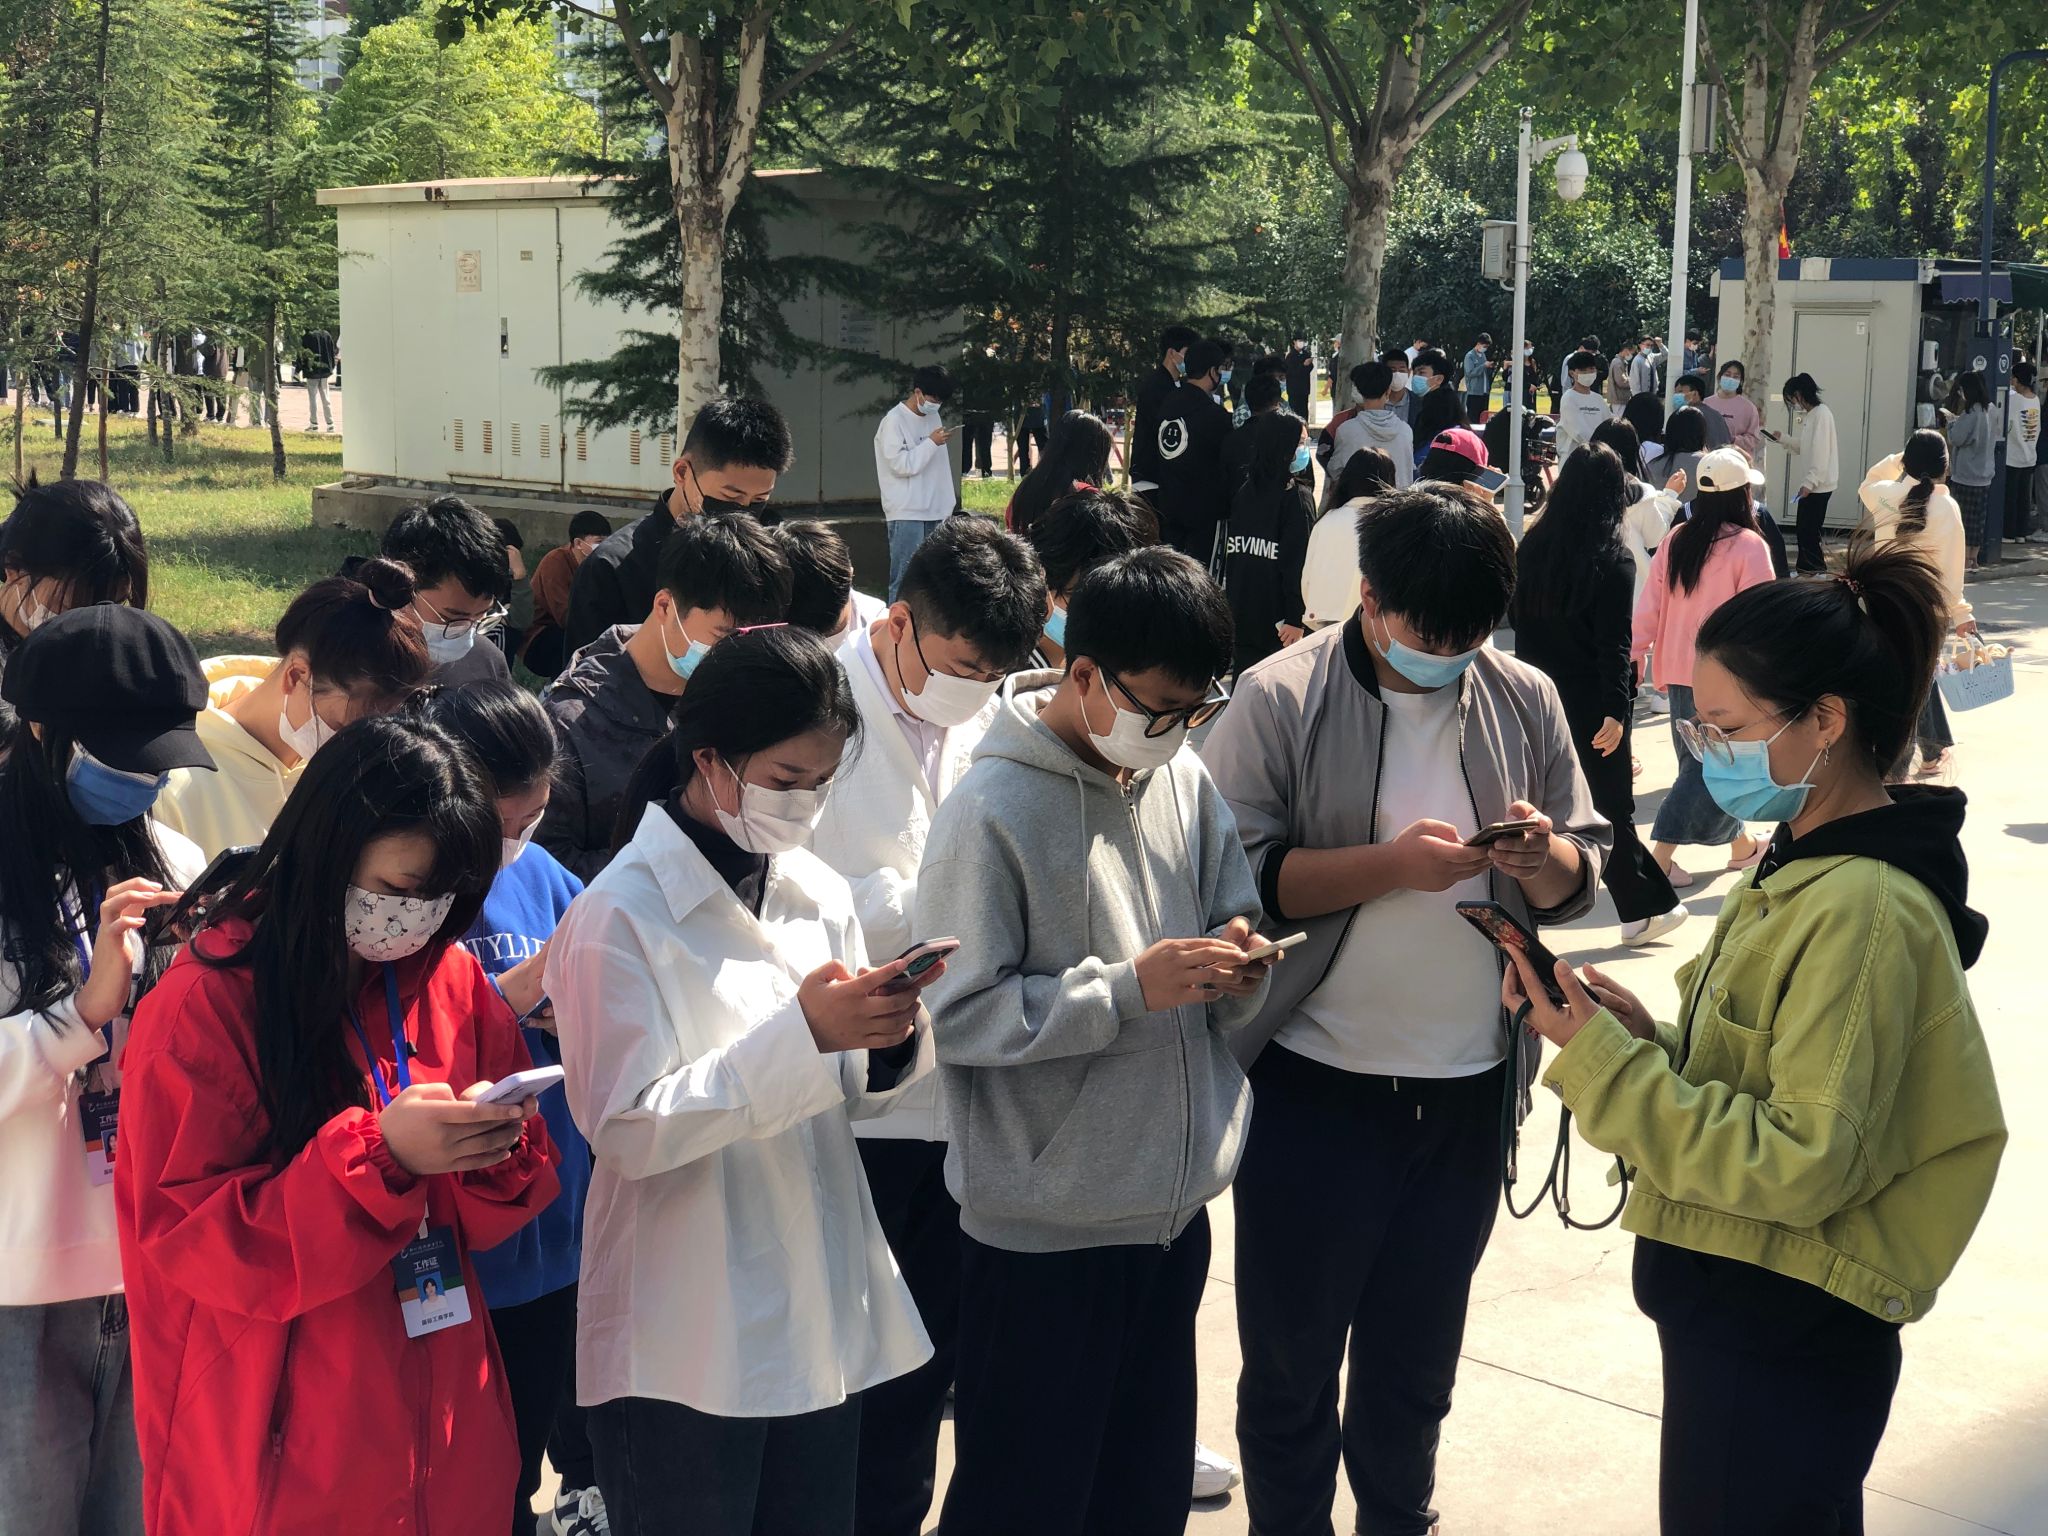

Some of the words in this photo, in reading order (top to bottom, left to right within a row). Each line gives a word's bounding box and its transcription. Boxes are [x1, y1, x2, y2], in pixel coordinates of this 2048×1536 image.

[1227, 535, 1279, 560] SEVNME
[413, 1256, 439, 1271] 工作证
